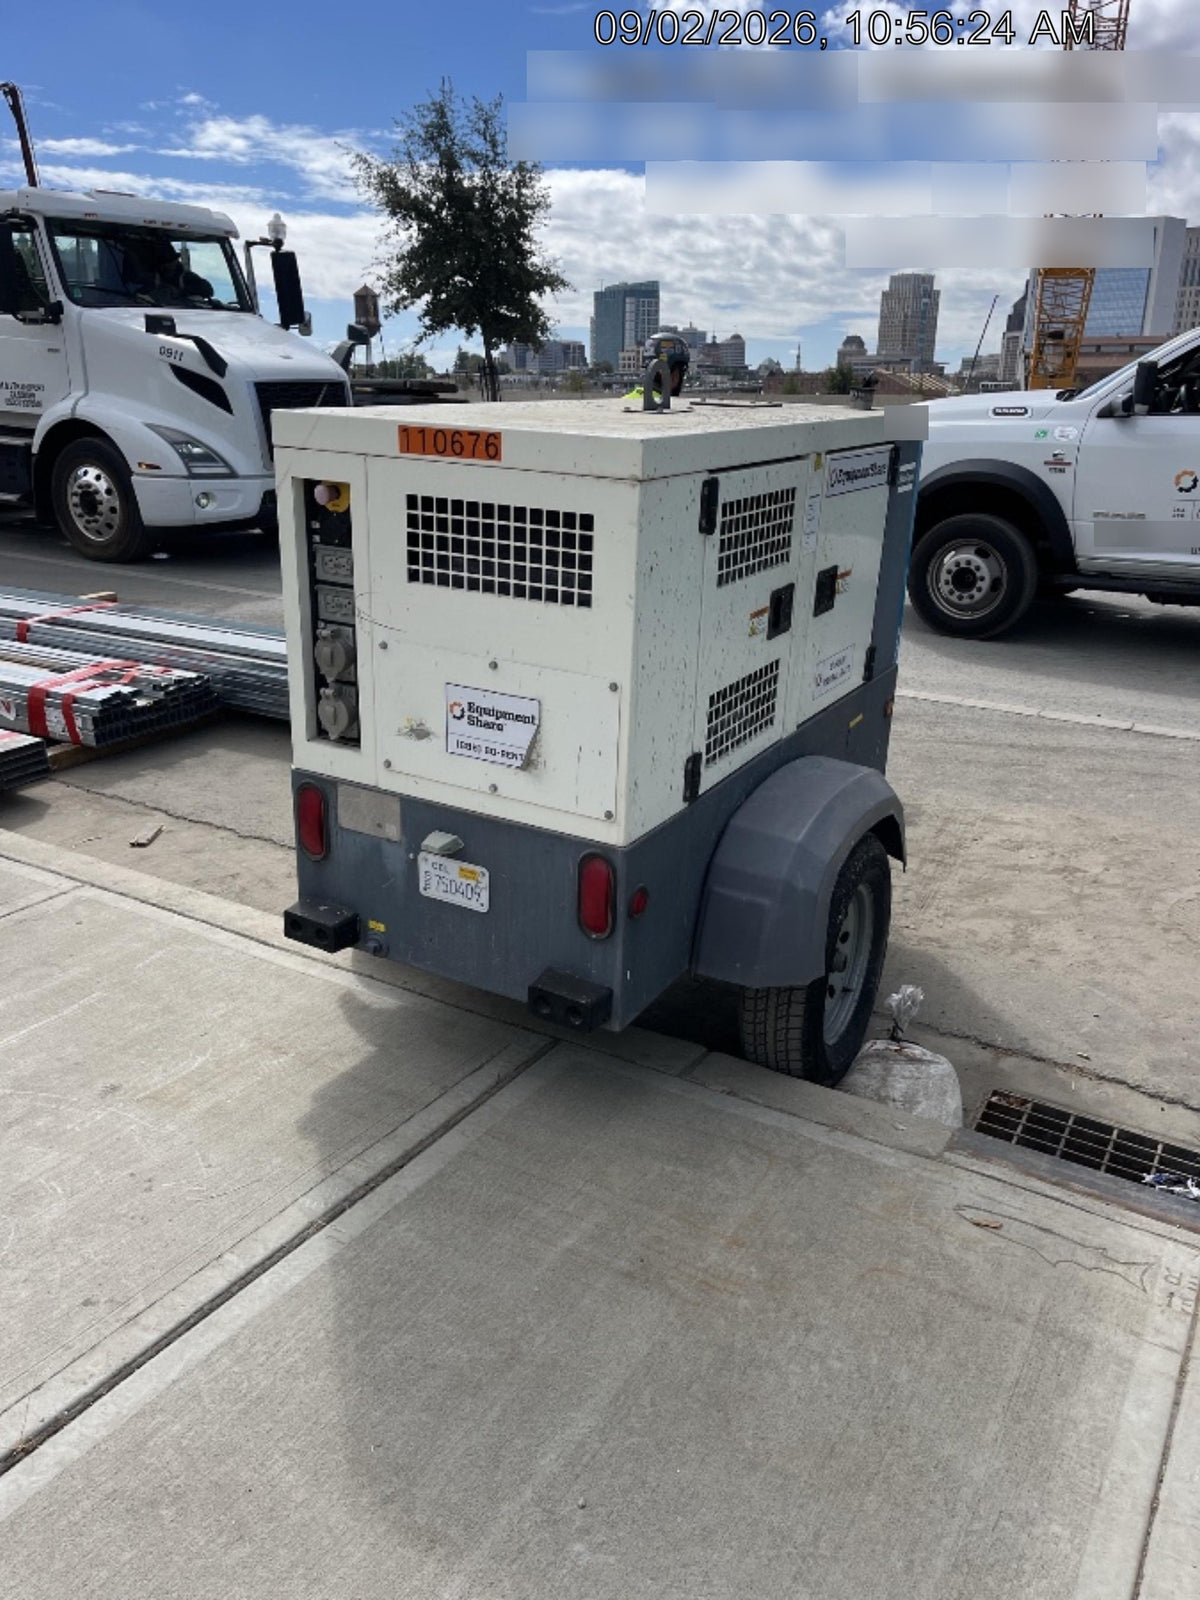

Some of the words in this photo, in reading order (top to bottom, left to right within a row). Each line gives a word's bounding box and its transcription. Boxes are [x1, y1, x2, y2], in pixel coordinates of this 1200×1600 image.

[159, 345, 184, 361] 0911
[401, 427, 499, 459] 110676
[467, 701, 536, 726] Equipment
[467, 714, 504, 732] Share
